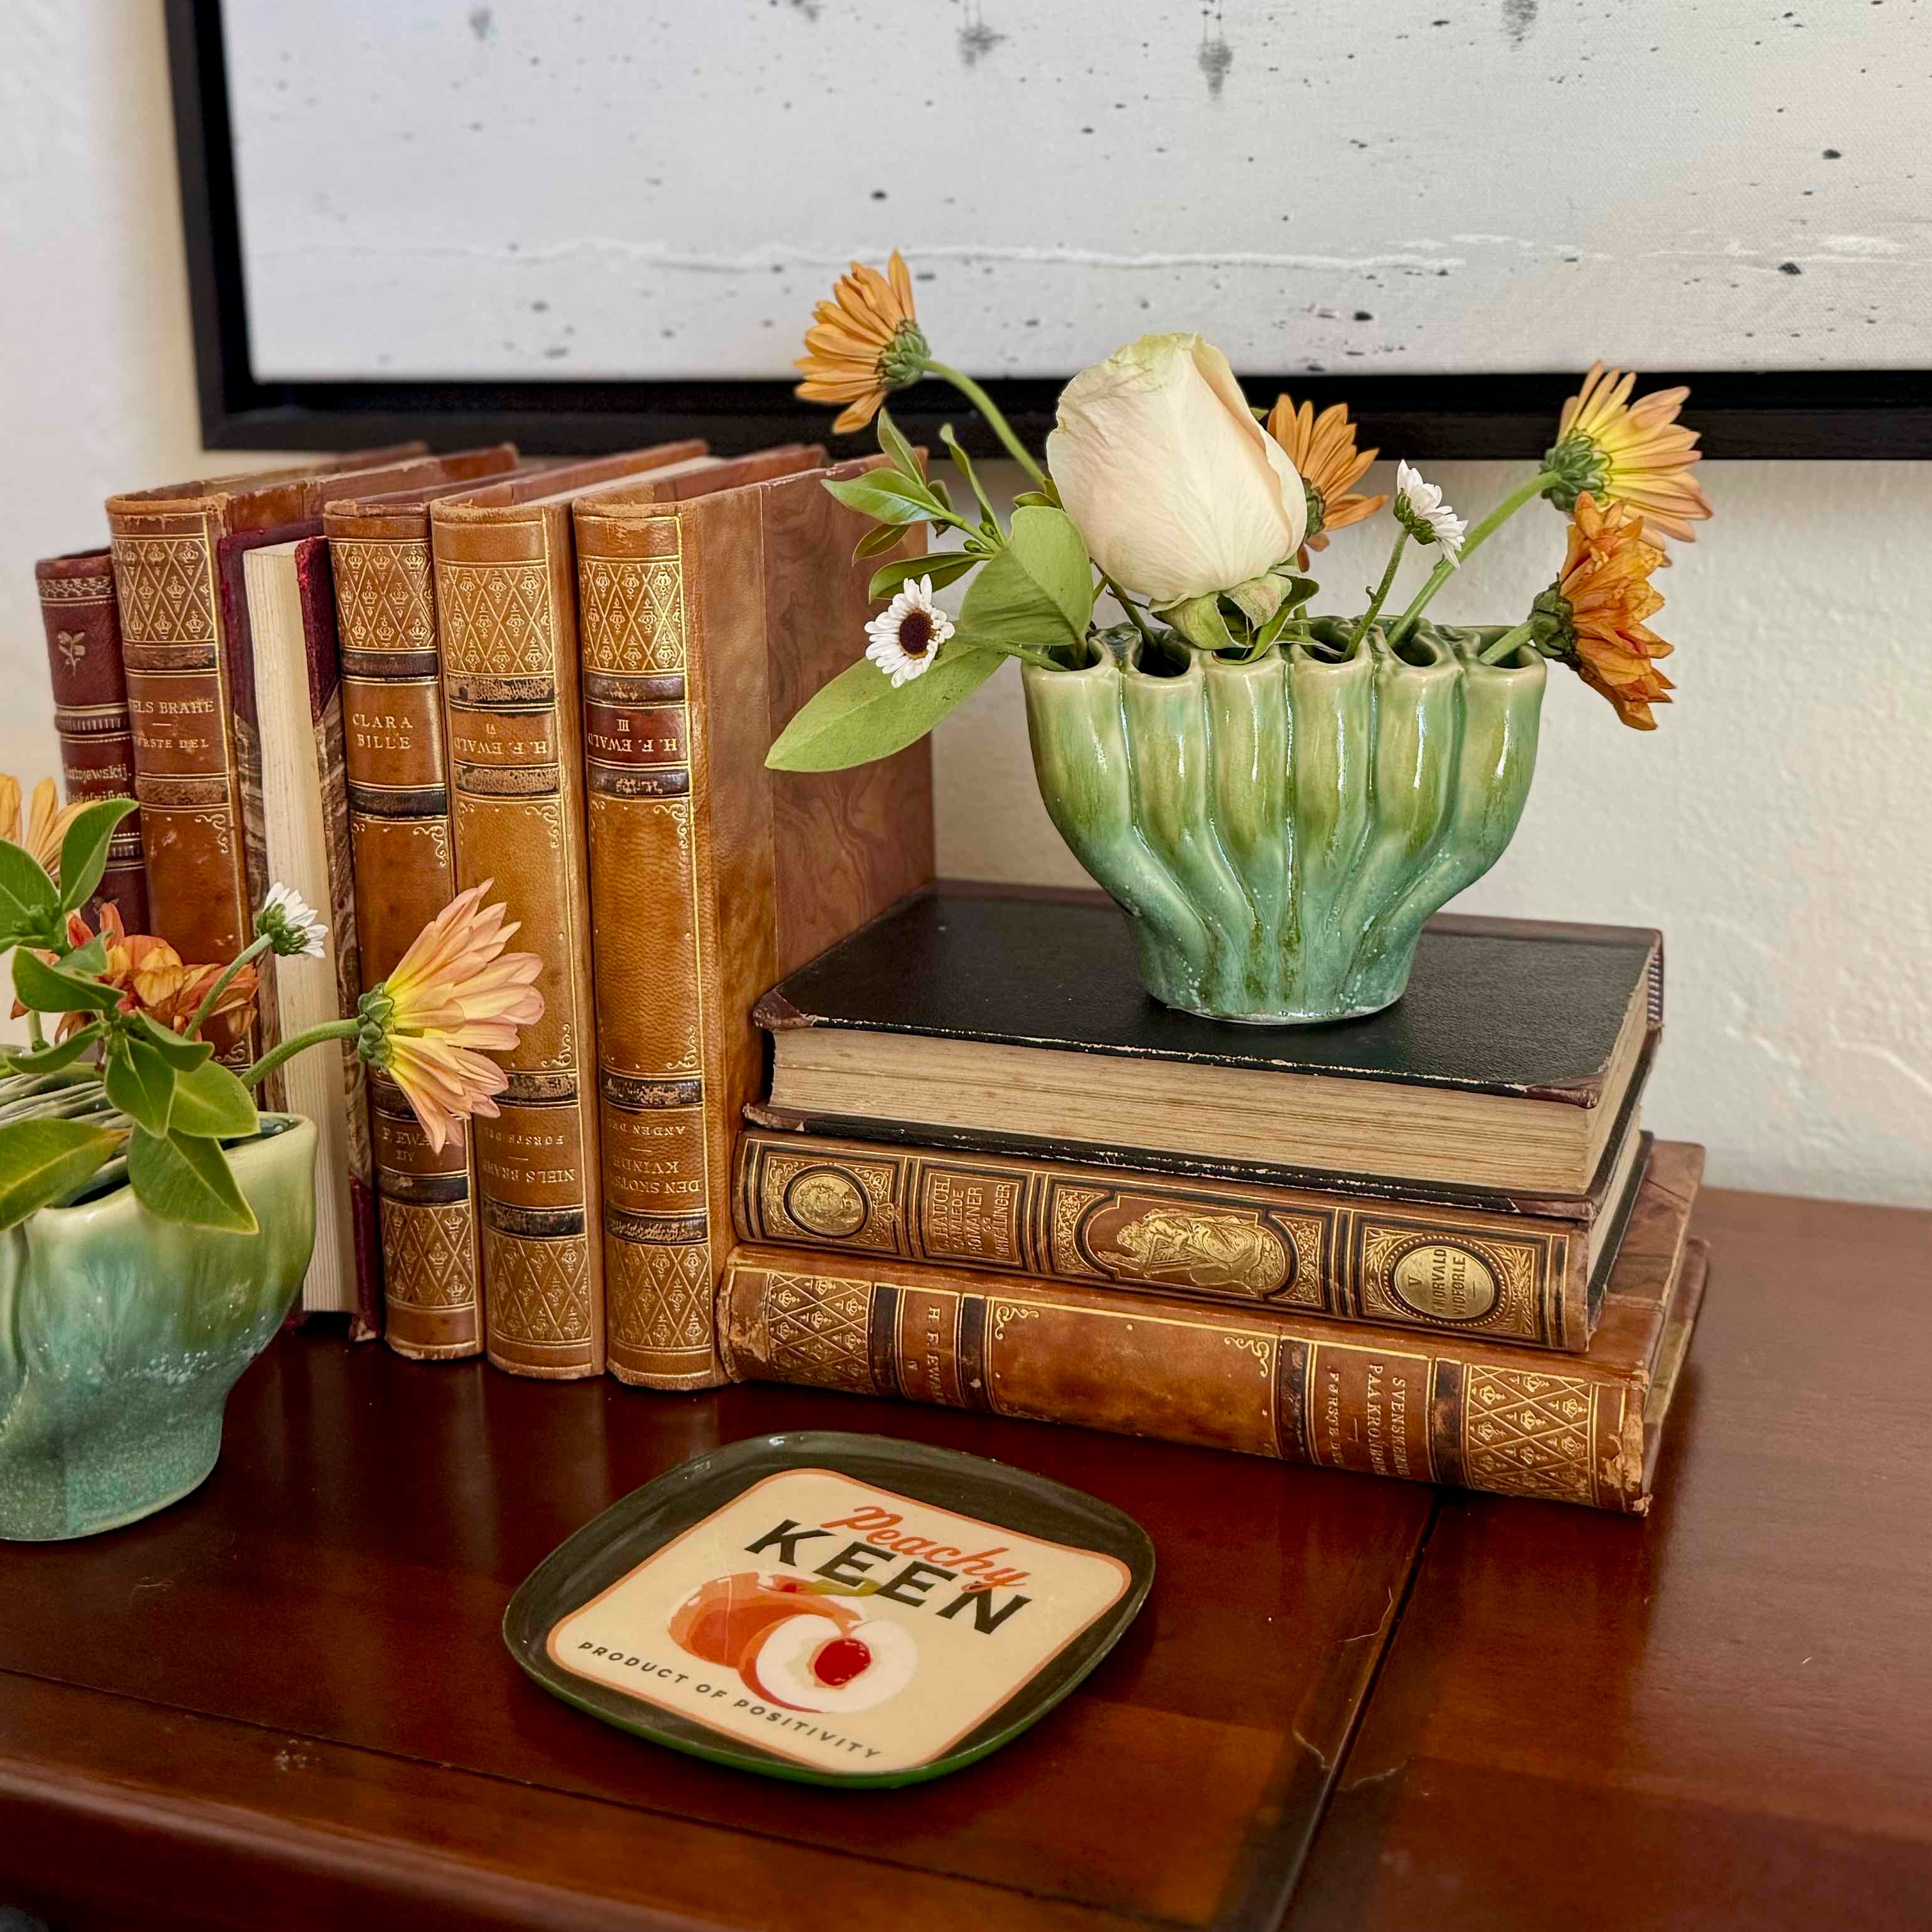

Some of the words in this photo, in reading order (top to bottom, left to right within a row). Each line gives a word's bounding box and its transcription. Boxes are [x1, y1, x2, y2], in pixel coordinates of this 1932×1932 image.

[159, 700, 215, 714] BRAHE
[353, 713, 414, 728] CLARA
[616, 719, 630, 732] III
[179, 739, 210, 749] DEL
[356, 734, 412, 749] BILLE
[454, 737, 503, 754] EWALD
[508, 742, 524, 754] F.
[529, 740, 548, 754] H.
[588, 733, 632, 752] EWALD
[638, 739, 654, 752] F.
[659, 738, 678, 752] H.
[632, 1124, 686, 1136] ANDEN
[526, 1169, 576, 1183] NIELS
[664, 1180, 704, 1193] DEN
[966, 1187, 983, 1254] ROMANER
[1408, 1274, 1422, 1287] V
[1432, 1249, 1447, 1313] THORVALD
[927, 1331, 939, 1347] F.
[1367, 1365, 1384, 1399] PAA
[820, 1506, 1032, 1593] Peachy
[744, 1518, 1033, 1636] KEEN
[578, 1641, 688, 1684] PRODUCT
[696, 1684, 728, 1699] OF
[734, 1699, 881, 1759] POSITIVITY
